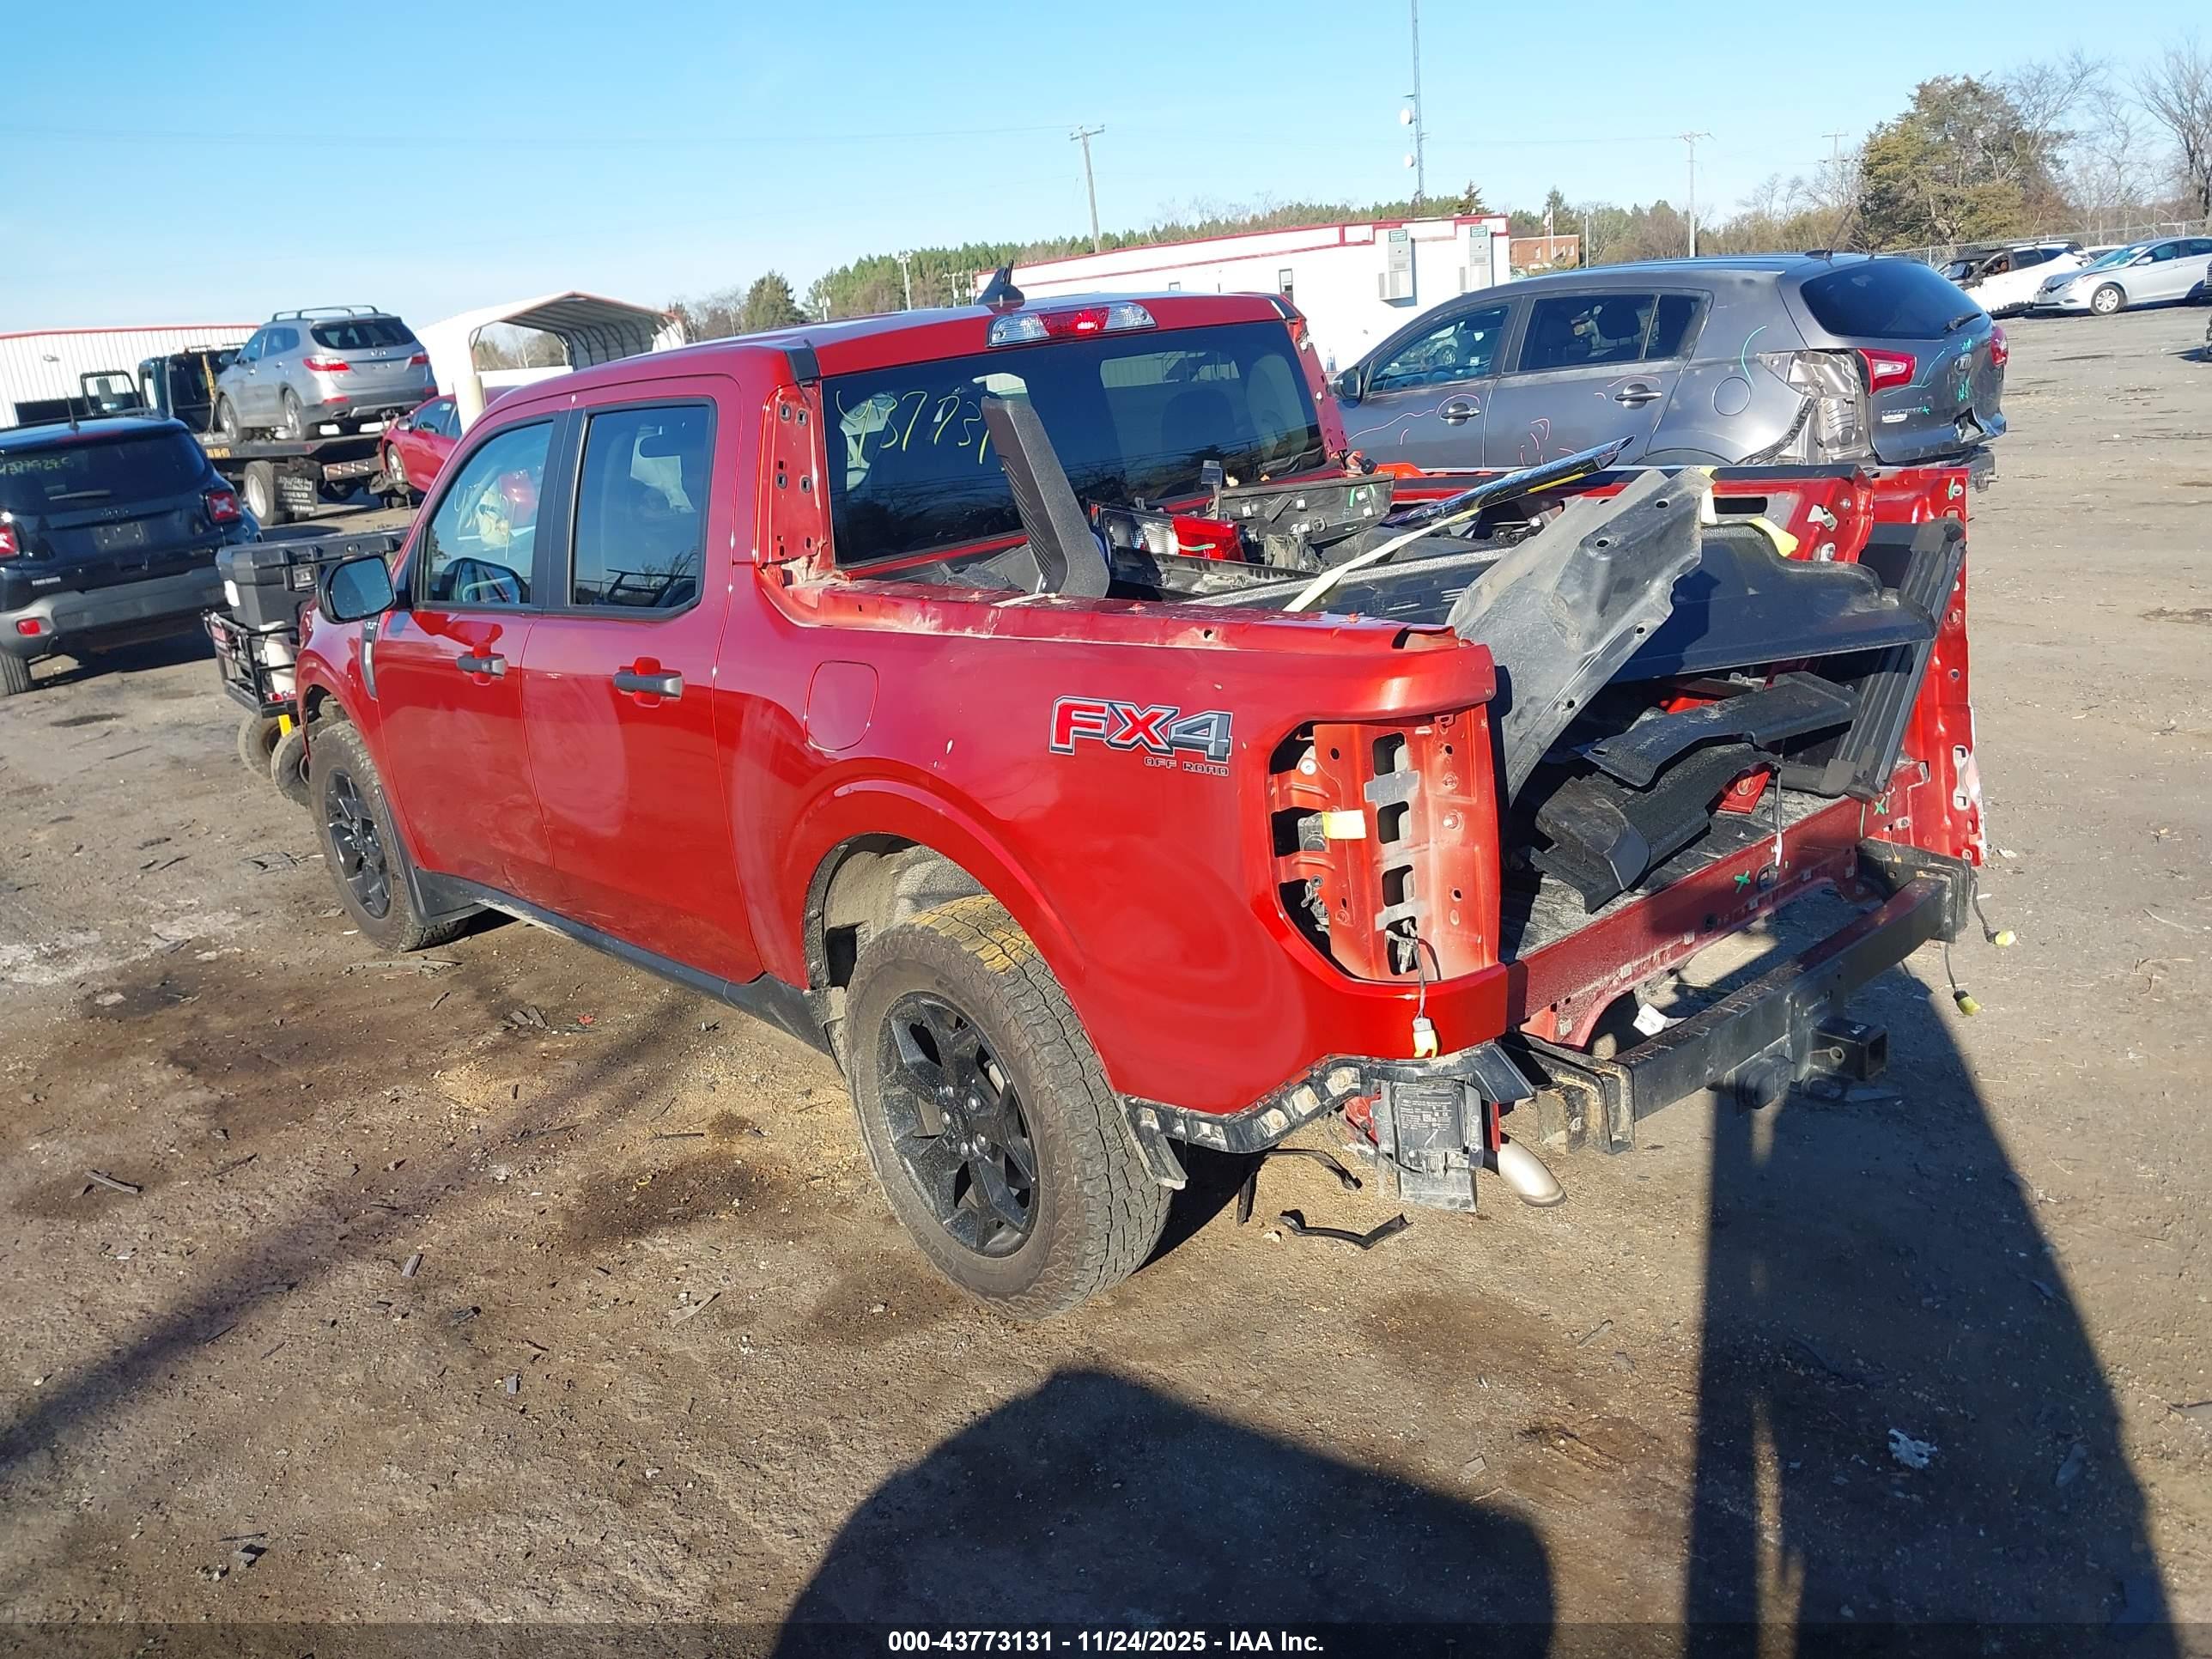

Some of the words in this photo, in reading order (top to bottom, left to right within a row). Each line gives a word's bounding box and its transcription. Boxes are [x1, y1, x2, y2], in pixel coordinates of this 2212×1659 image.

[1048, 695, 1234, 763] FX4
[1144, 756, 1177, 769] OFF
[1183, 761, 1230, 776] ROAD
